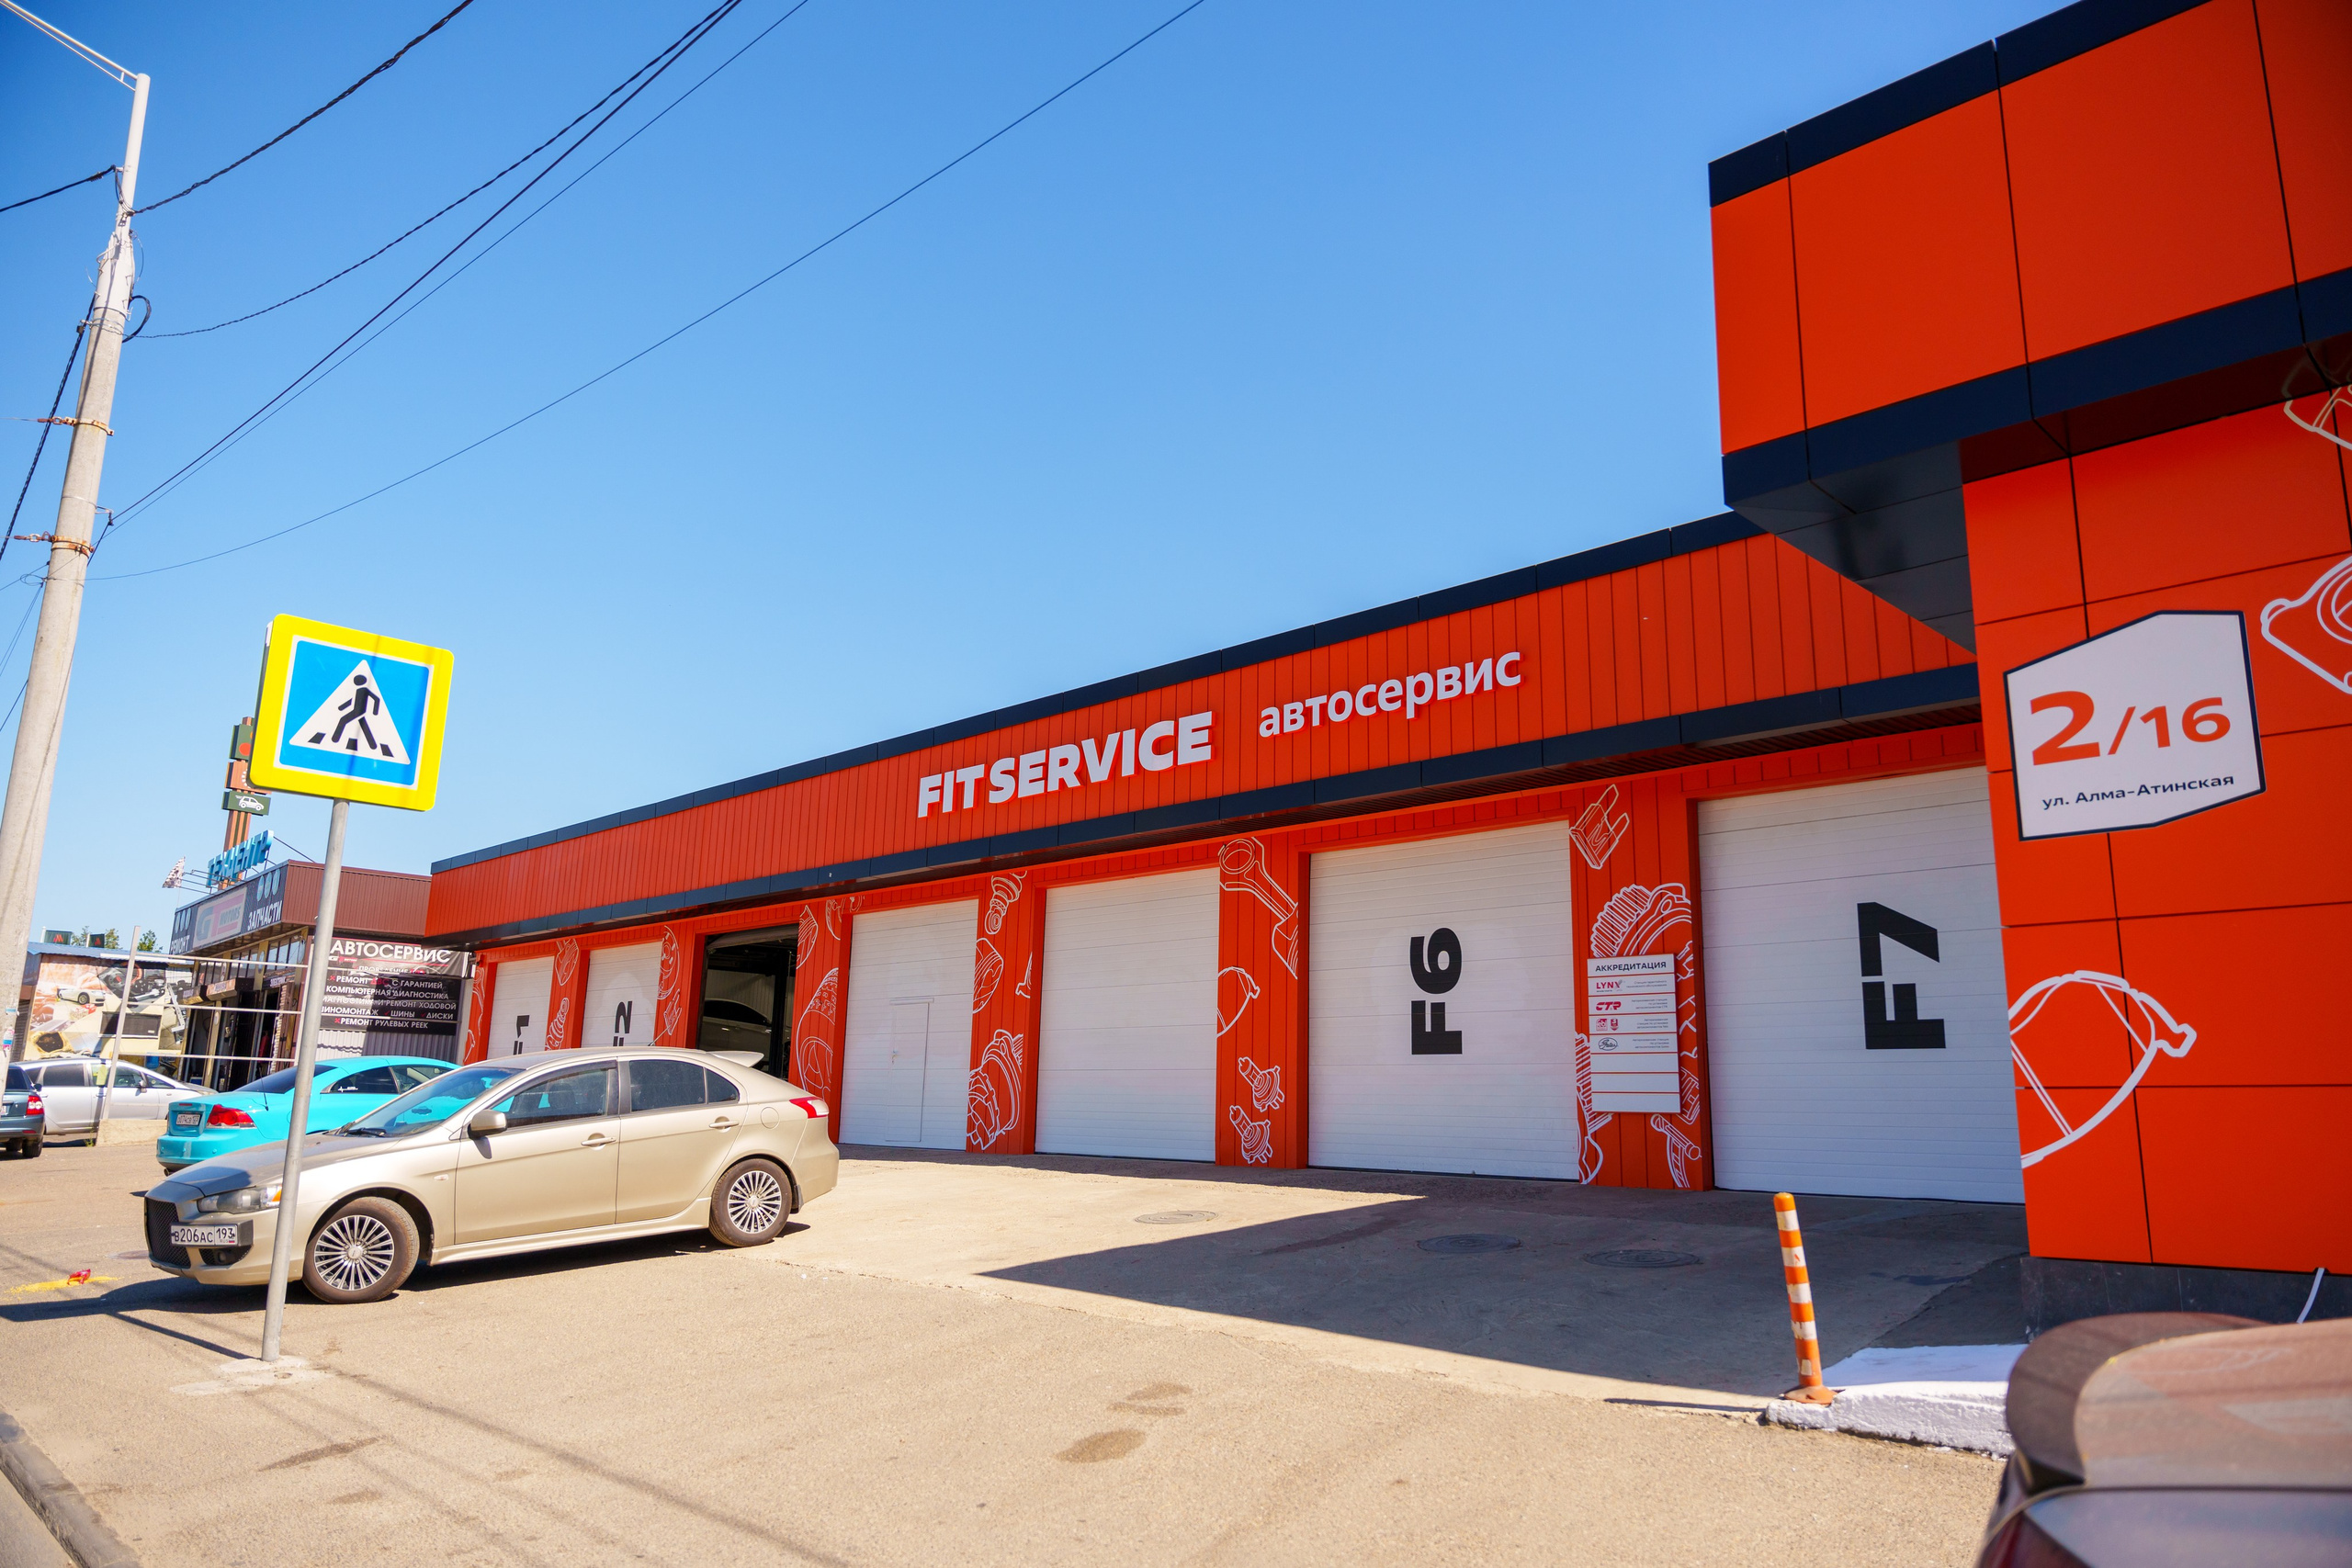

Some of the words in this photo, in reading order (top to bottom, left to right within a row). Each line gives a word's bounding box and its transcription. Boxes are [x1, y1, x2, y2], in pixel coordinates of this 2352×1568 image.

[1259, 651, 1522, 738] автосервис
[2030, 690, 2232, 766] 2/16
[917, 762, 985, 818] FIT
[988, 710, 1215, 803] SERVICE
[2042, 795, 2069, 810] ул.
[2075, 775, 2234, 804] Алма-Атинская
[247, 900, 283, 931] ЗАПЧАСТИ
[330, 940, 451, 964] АВТОСЕРВИС
[1595, 961, 1667, 972] АККРЕДИТАЦИЯ
[1857, 901, 1946, 1049] F7
[326, 985, 391, 997] КОМПЬЮТЕРНАЯ
[393, 989, 449, 999] ДИАГНОСТИКА
[336, 976, 369, 985] РЕМОНТ
[401, 979, 443, 989] ГАРАНТИЕЙ
[1409, 927, 1463, 1055] F6
[1596, 979, 1623, 989] LYNX
[386, 999, 417, 1008] РЕМОНТ
[419, 1000, 457, 1010] ХОДОВОЙ
[340, 1017, 373, 1026] РЕМОНТ
[375, 1018, 409, 1028] РУЛЕВЫХ
[412, 1021, 428, 1029] РЕЕК
[426, 1011, 454, 1020] ДИСКИ
[175, 1228, 213, 1243] В206АС
[216, 1227, 233, 1239] 193
